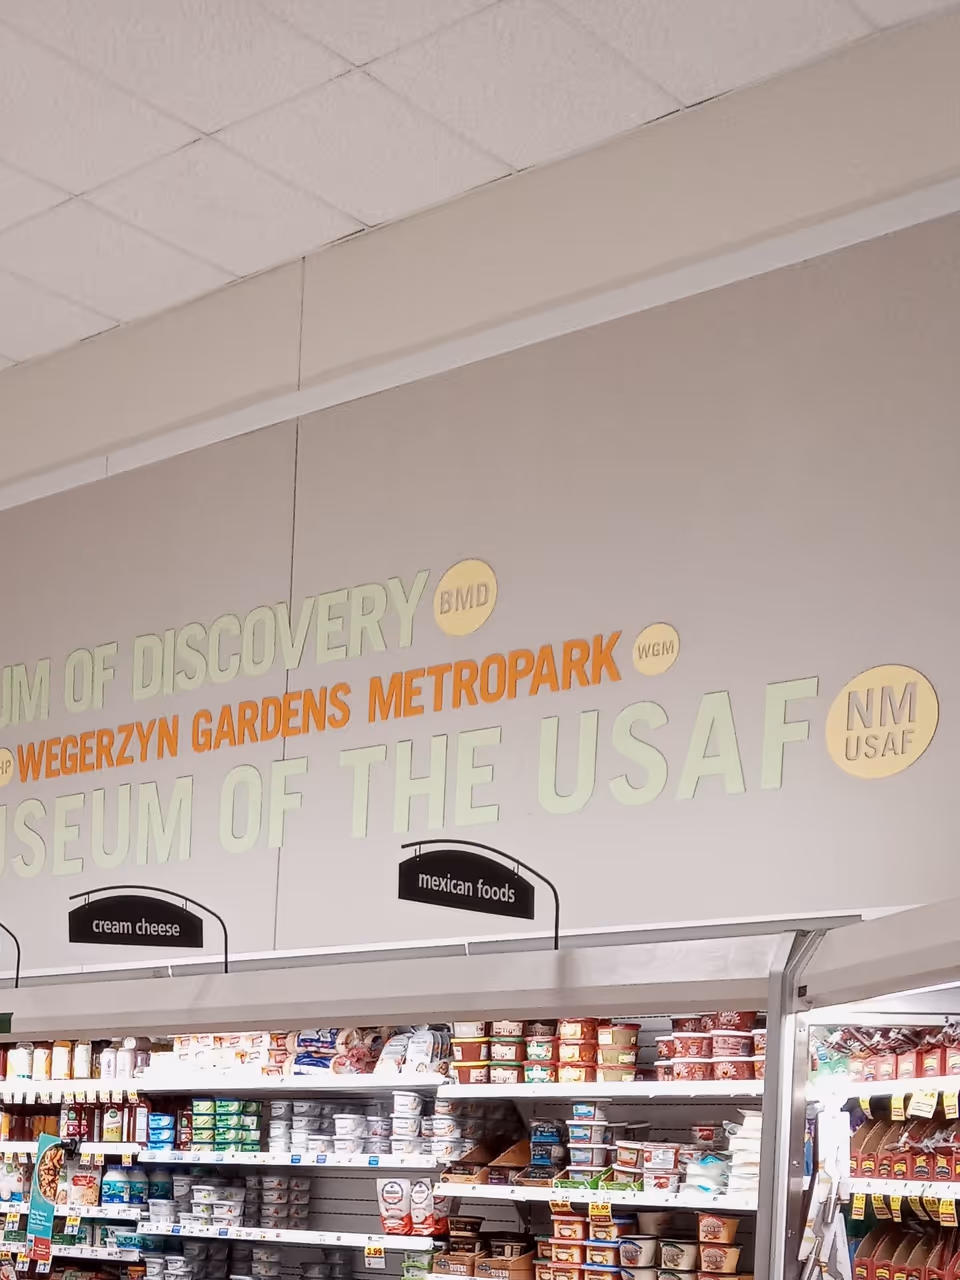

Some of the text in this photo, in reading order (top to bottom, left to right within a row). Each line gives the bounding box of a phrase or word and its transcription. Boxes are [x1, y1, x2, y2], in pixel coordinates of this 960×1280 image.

[440, 582, 489, 616] BMD
[63, 641, 119, 714] OF
[132, 569, 431, 701] DISCOVERY
[638, 638, 675, 662] WGM
[17, 631, 623, 783] WEGERZYN GARDENS METROPARK
[846, 682, 918, 732] NM
[217, 755, 309, 855] OF
[339, 725, 502, 840] THE
[538, 676, 820, 815] USAF
[844, 732, 915, 762] USAF
[418, 868, 516, 905] mexican foods
[92, 917, 181, 937] cream cheese
